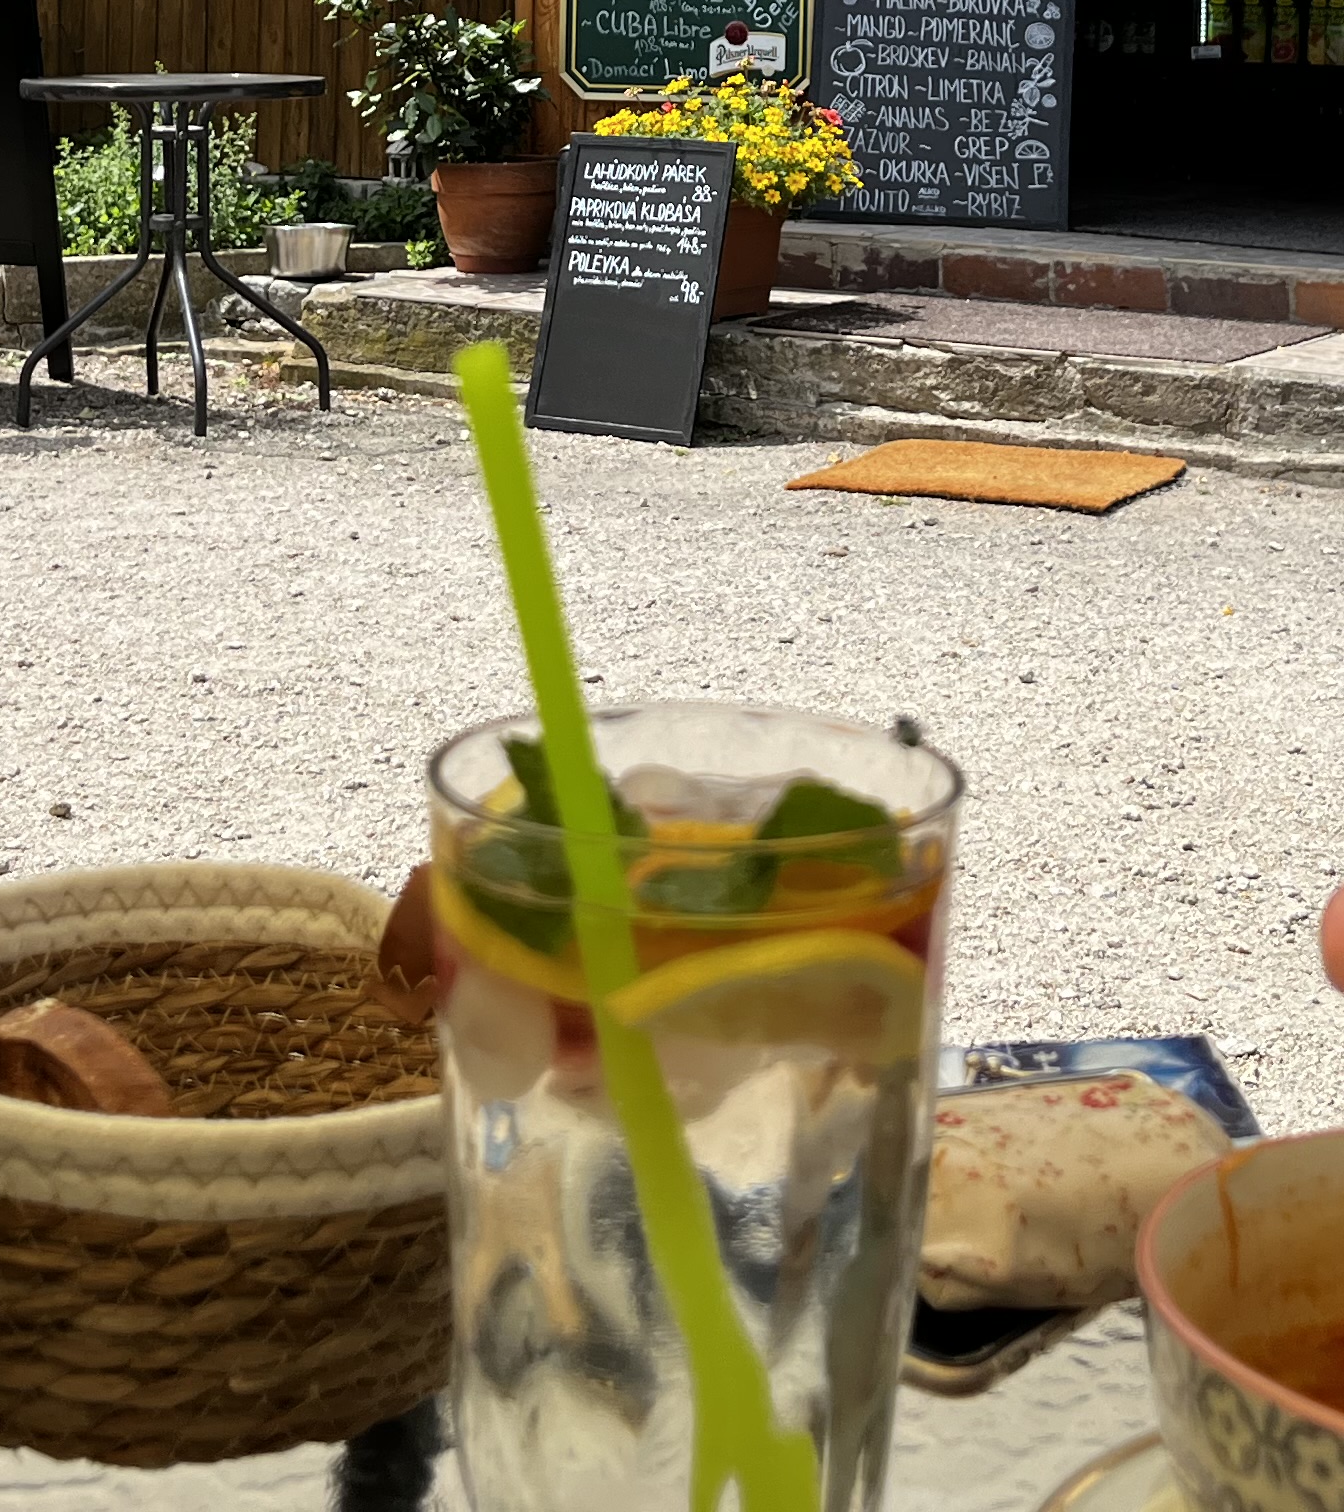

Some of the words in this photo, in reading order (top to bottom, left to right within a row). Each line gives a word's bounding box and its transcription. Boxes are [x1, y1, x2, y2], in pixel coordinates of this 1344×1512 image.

[596, 10, 657, 38] CUBA
[663, 15, 712, 38] Libre
[591, 56, 658, 79] Domácí
[877, 44, 950, 69] BROSKEV
[846, 74, 909, 100] CITRON
[927, 76, 1006, 105] LIMETKA
[875, 106, 950, 131] ANANAS
[954, 136, 1010, 160] GREP
[661, 158, 707, 184] PÁREK
[879, 159, 951, 187] OKURKA
[569, 195, 637, 221] PAPRIKOVÁ
[640, 195, 701, 224] KLOBÁSA
[567, 248, 630, 276] POLÉVKA
